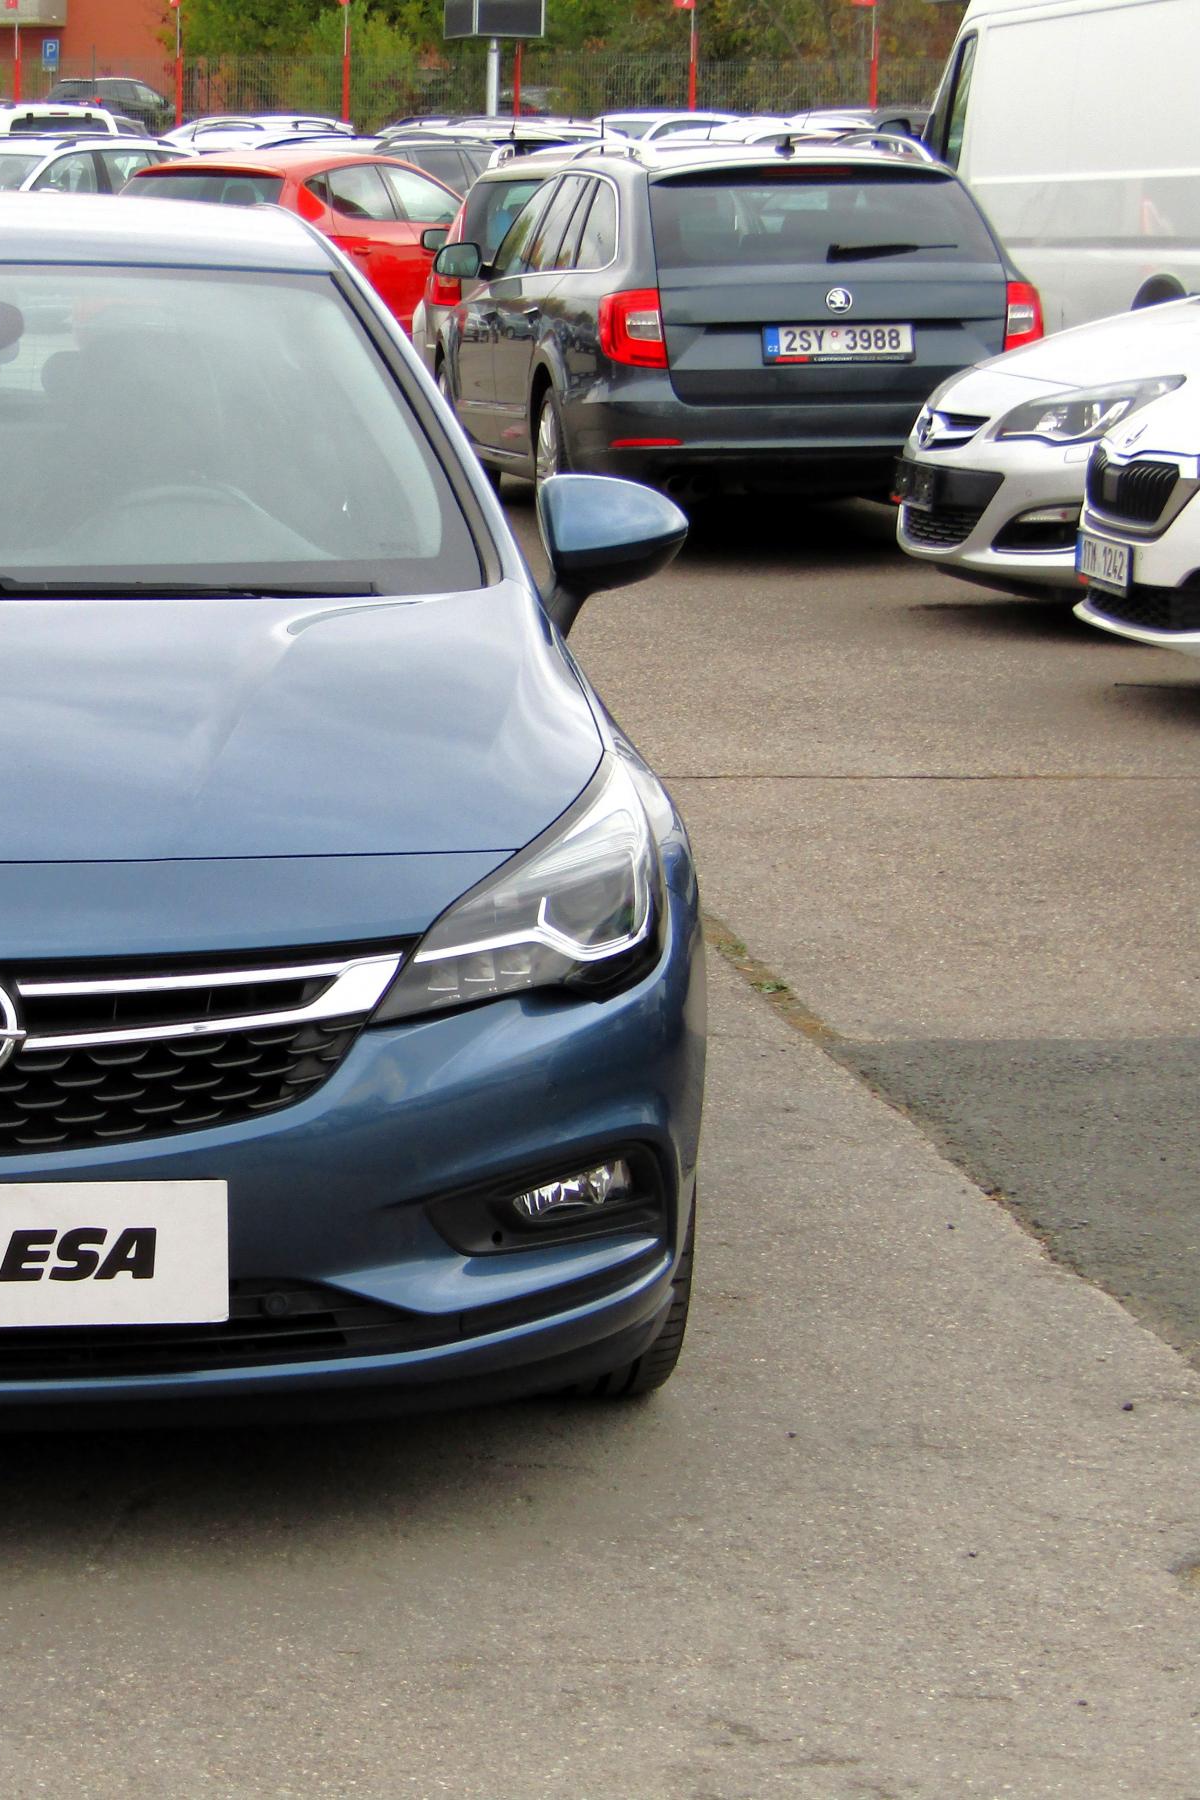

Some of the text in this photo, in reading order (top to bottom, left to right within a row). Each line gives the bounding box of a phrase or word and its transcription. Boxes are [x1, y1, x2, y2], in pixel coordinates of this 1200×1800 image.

[46, 43, 56, 57] P
[767, 345, 779, 353] CZ
[783, 328, 901, 352] 2SY 3988
[1103, 545, 1124, 581] 1242
